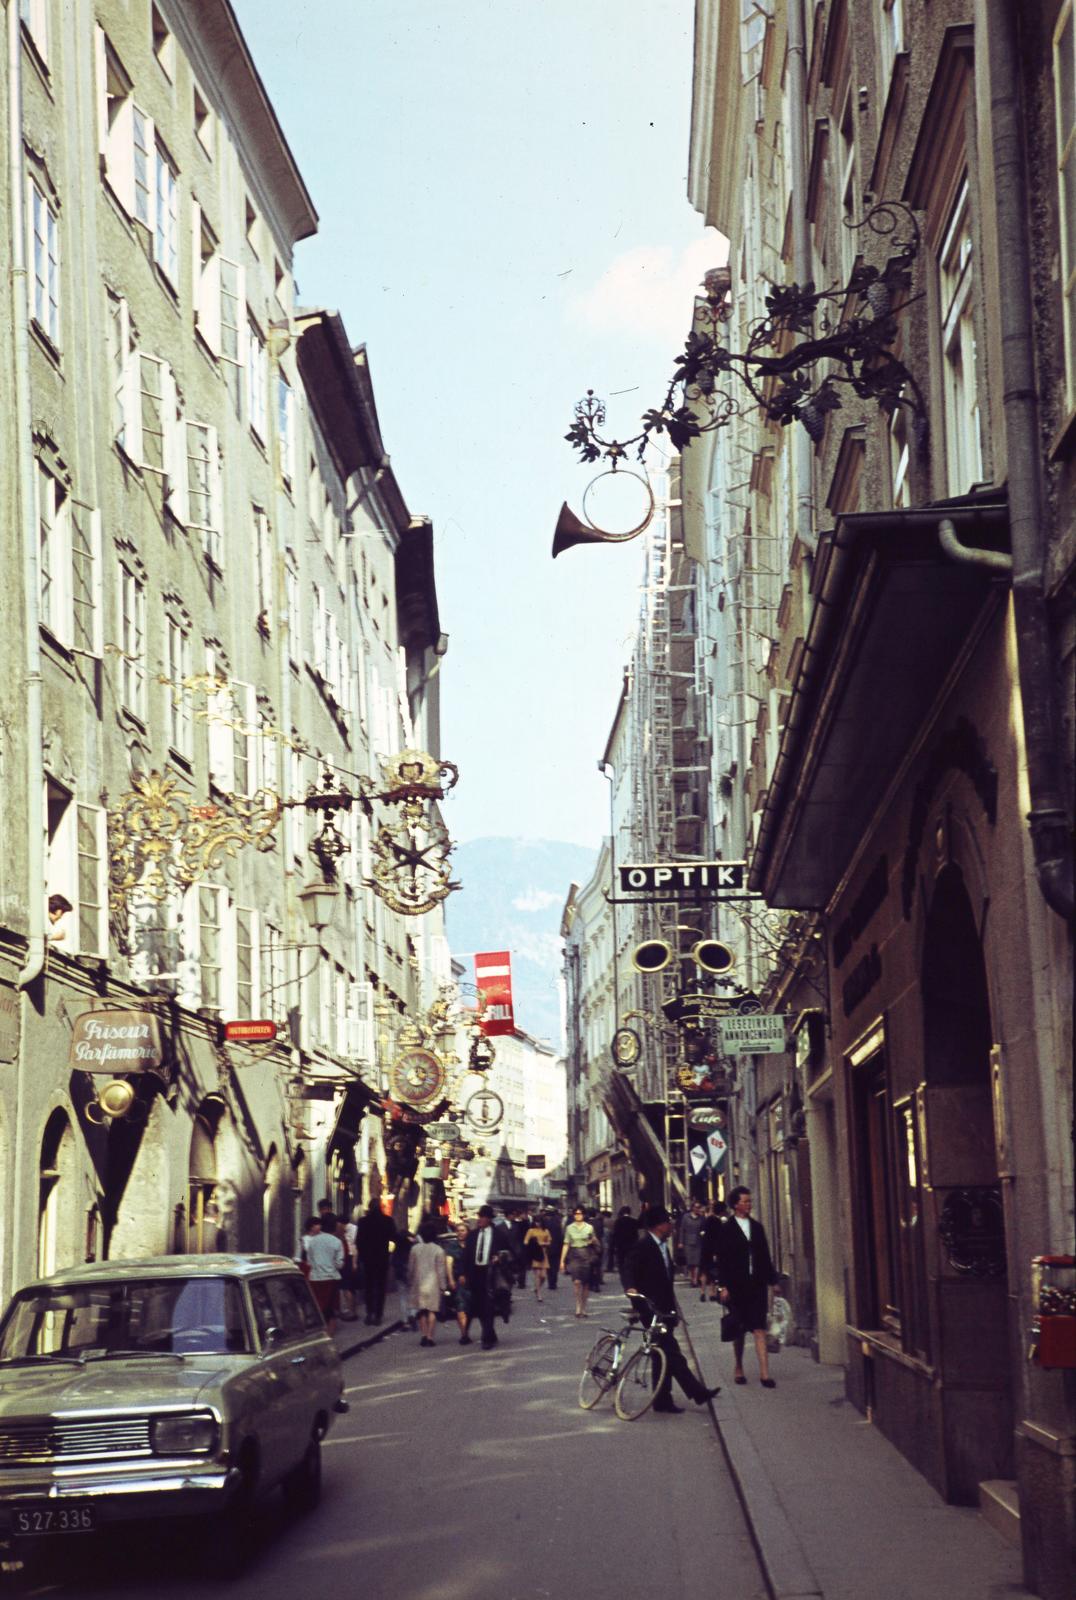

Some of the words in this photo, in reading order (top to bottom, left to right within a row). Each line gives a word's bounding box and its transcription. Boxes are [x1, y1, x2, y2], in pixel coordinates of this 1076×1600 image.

[628, 866, 735, 887] OPTIK
[84, 1019, 149, 1040] Friseur
[75, 1041, 157, 1066] Parfümerie
